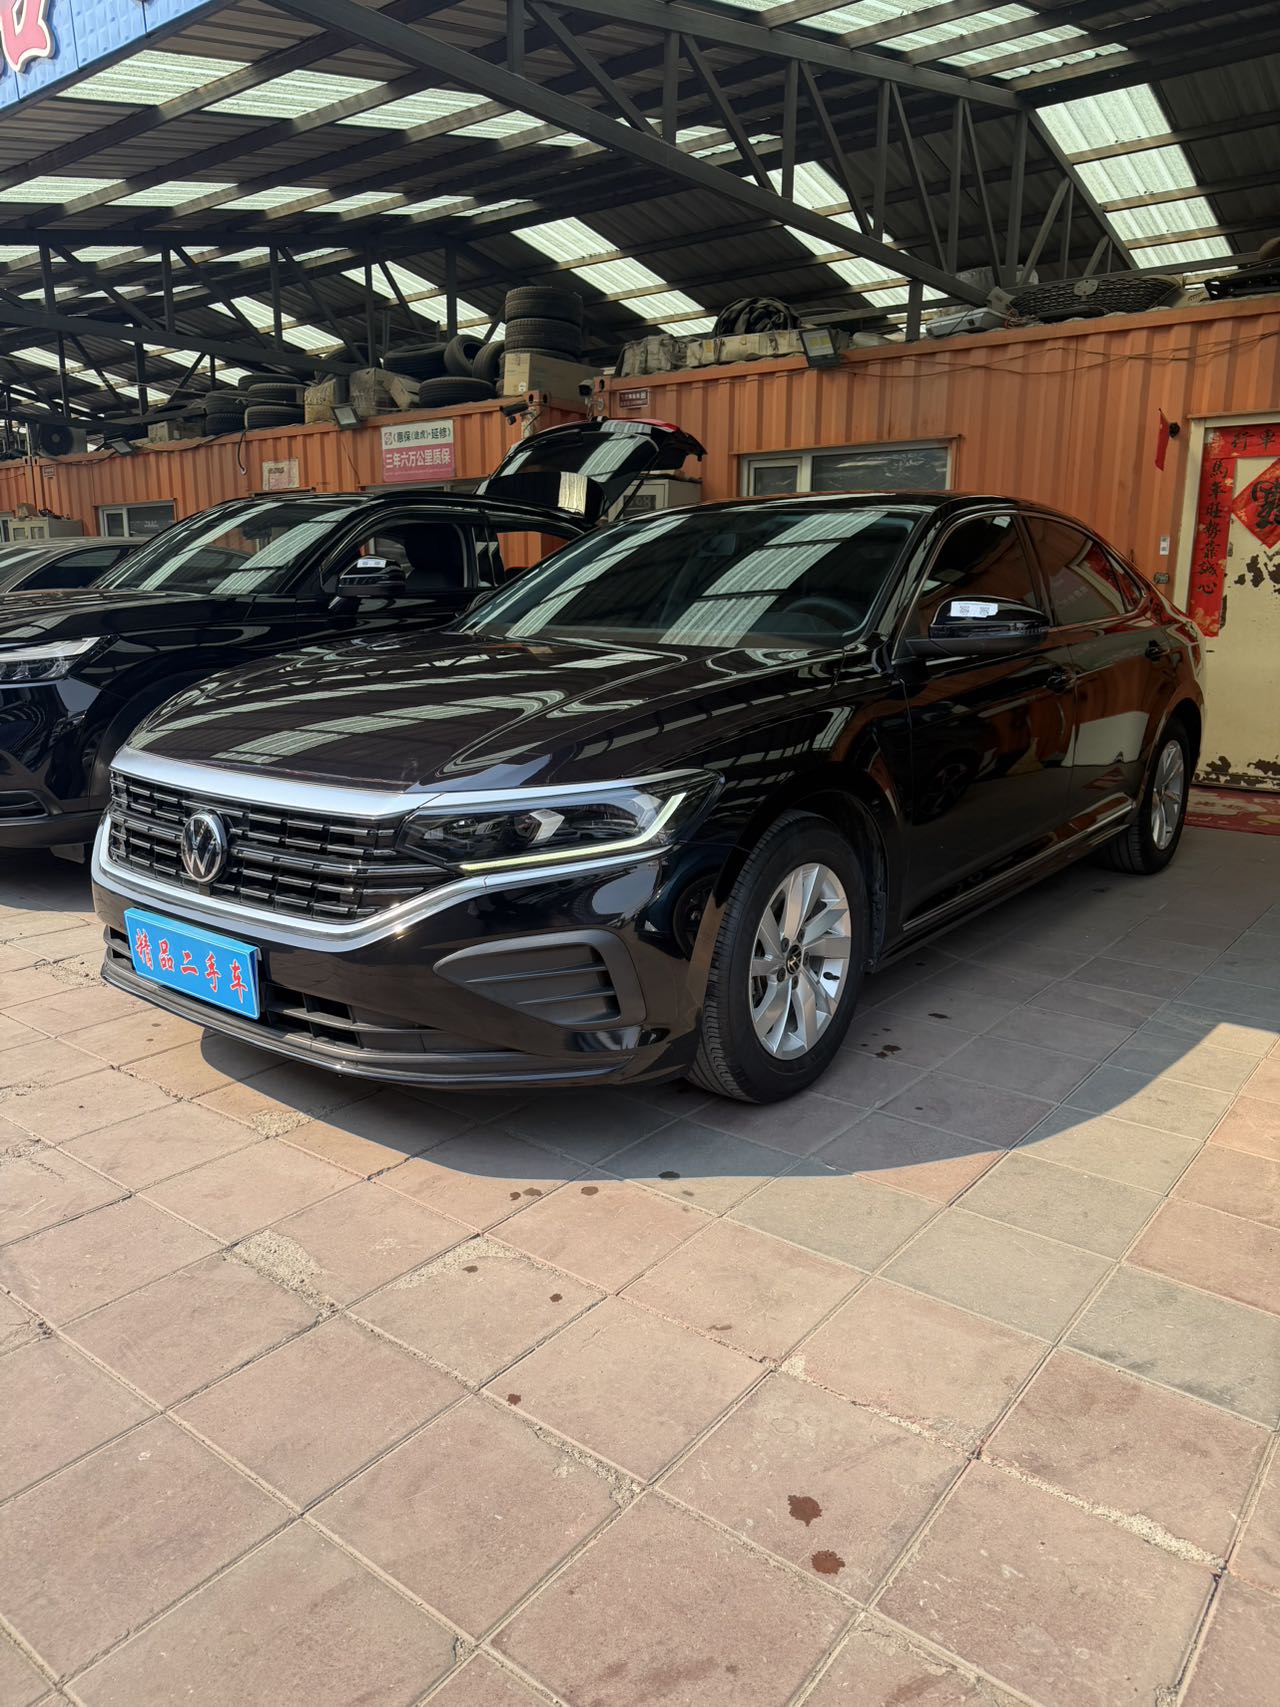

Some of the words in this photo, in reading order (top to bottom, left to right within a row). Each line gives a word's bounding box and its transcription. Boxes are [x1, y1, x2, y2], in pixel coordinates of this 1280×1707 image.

[386, 448, 451, 468] 三年六万公里质保
[134, 927, 249, 1005] 精品二手车
